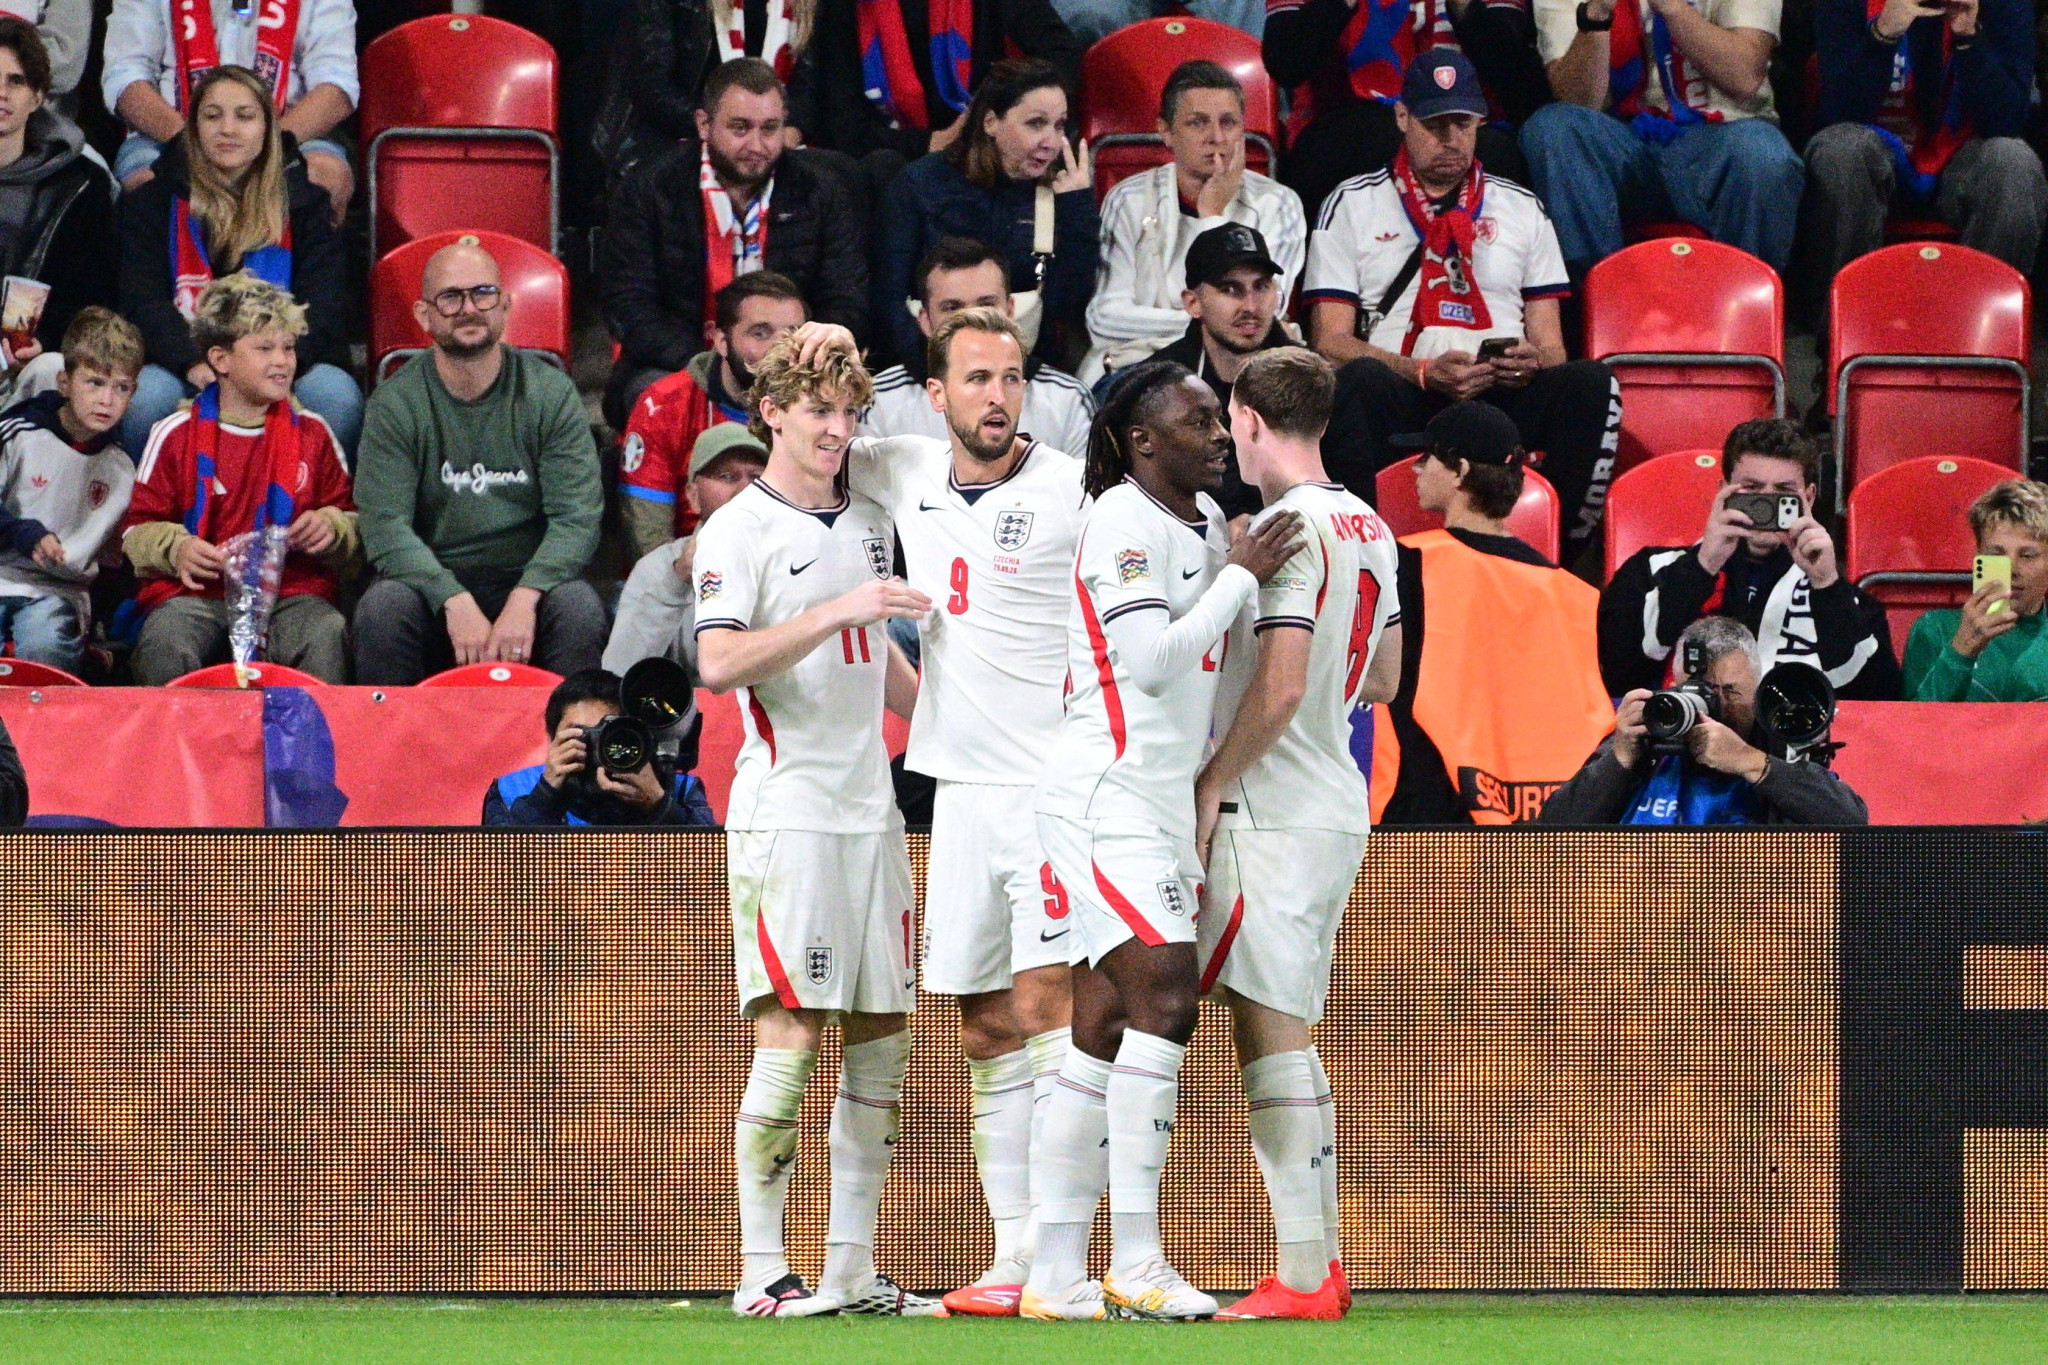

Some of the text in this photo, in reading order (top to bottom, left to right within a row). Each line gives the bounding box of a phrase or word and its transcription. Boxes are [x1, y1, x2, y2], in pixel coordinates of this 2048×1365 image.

[947, 557, 969, 615] 9
[841, 626, 871, 664] 11
[1040, 861, 1071, 920] 9
[1154, 1119, 1173, 1133] EN
